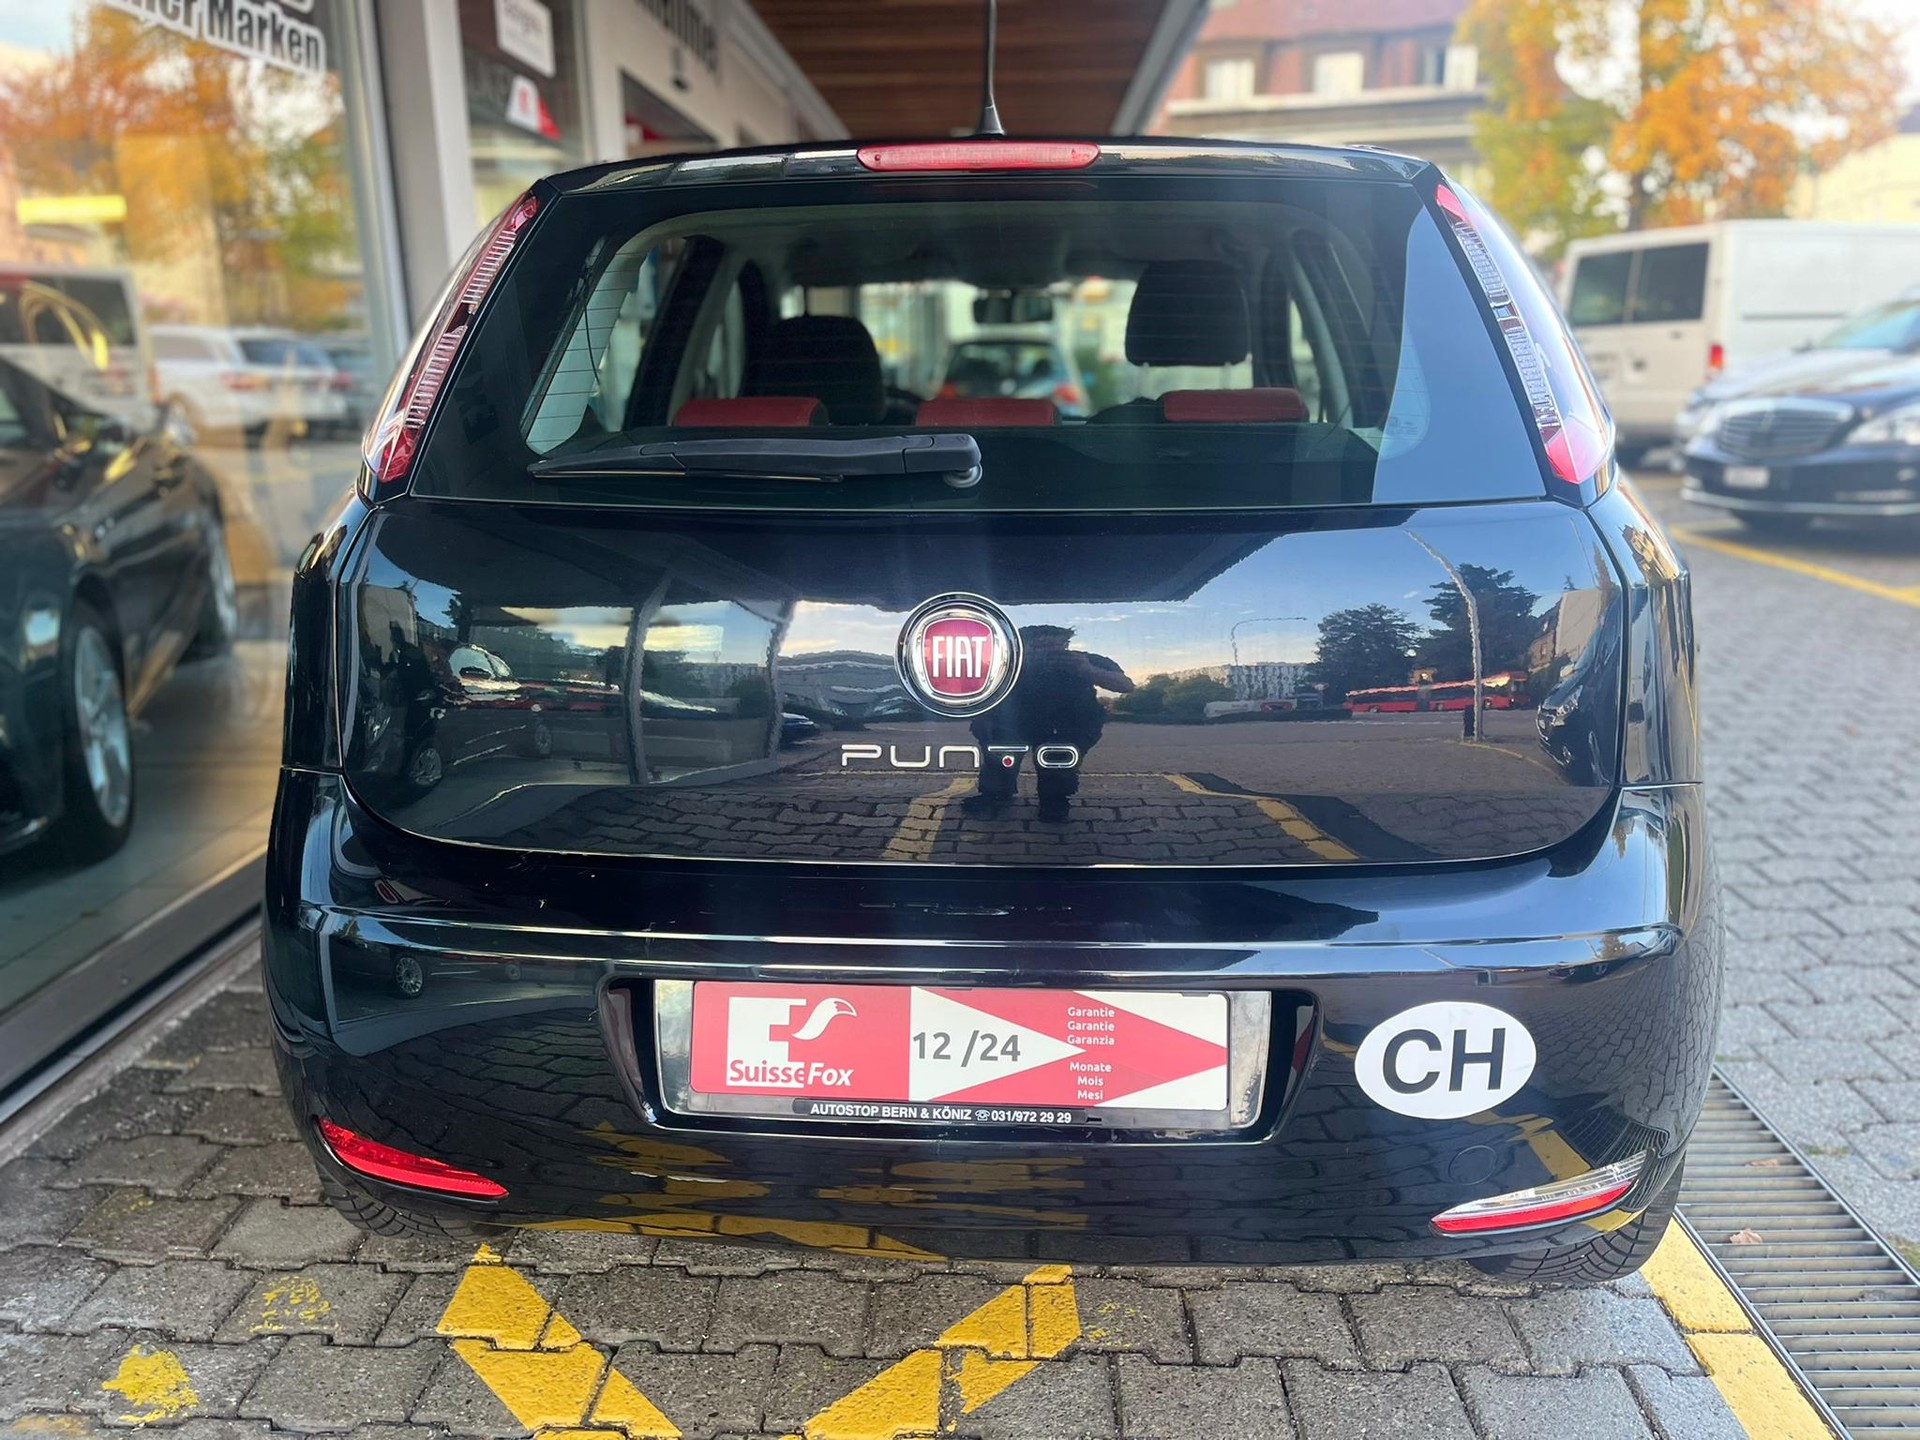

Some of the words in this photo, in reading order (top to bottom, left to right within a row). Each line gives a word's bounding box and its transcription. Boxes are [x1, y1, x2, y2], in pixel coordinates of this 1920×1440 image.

[207, 0, 320, 70] Marken
[931, 635, 988, 678] FIAT
[841, 744, 1079, 768] PUNTO
[1067, 1006, 1115, 1017] Garantie
[1067, 1020, 1115, 1031] Garantie
[913, 1032, 951, 1060] 12
[1067, 1034, 1115, 1045] Garanzia
[1069, 1061, 1112, 1072] Monate
[1382, 1028, 1506, 1094] CH
[1077, 1075, 1104, 1086] Mois
[1077, 1089, 1104, 1100] Mesi
[810, 1103, 880, 1117] AUTOSTOP
[881, 1106, 918, 1118] BERN
[920, 1107, 930, 1119] &
[932, 1105, 972, 1121] KÖNIZ
[991, 1110, 1037, 1122] 031/972
[1039, 1112, 1055, 1123] 29
[1056, 1112, 1072, 1124] 29
